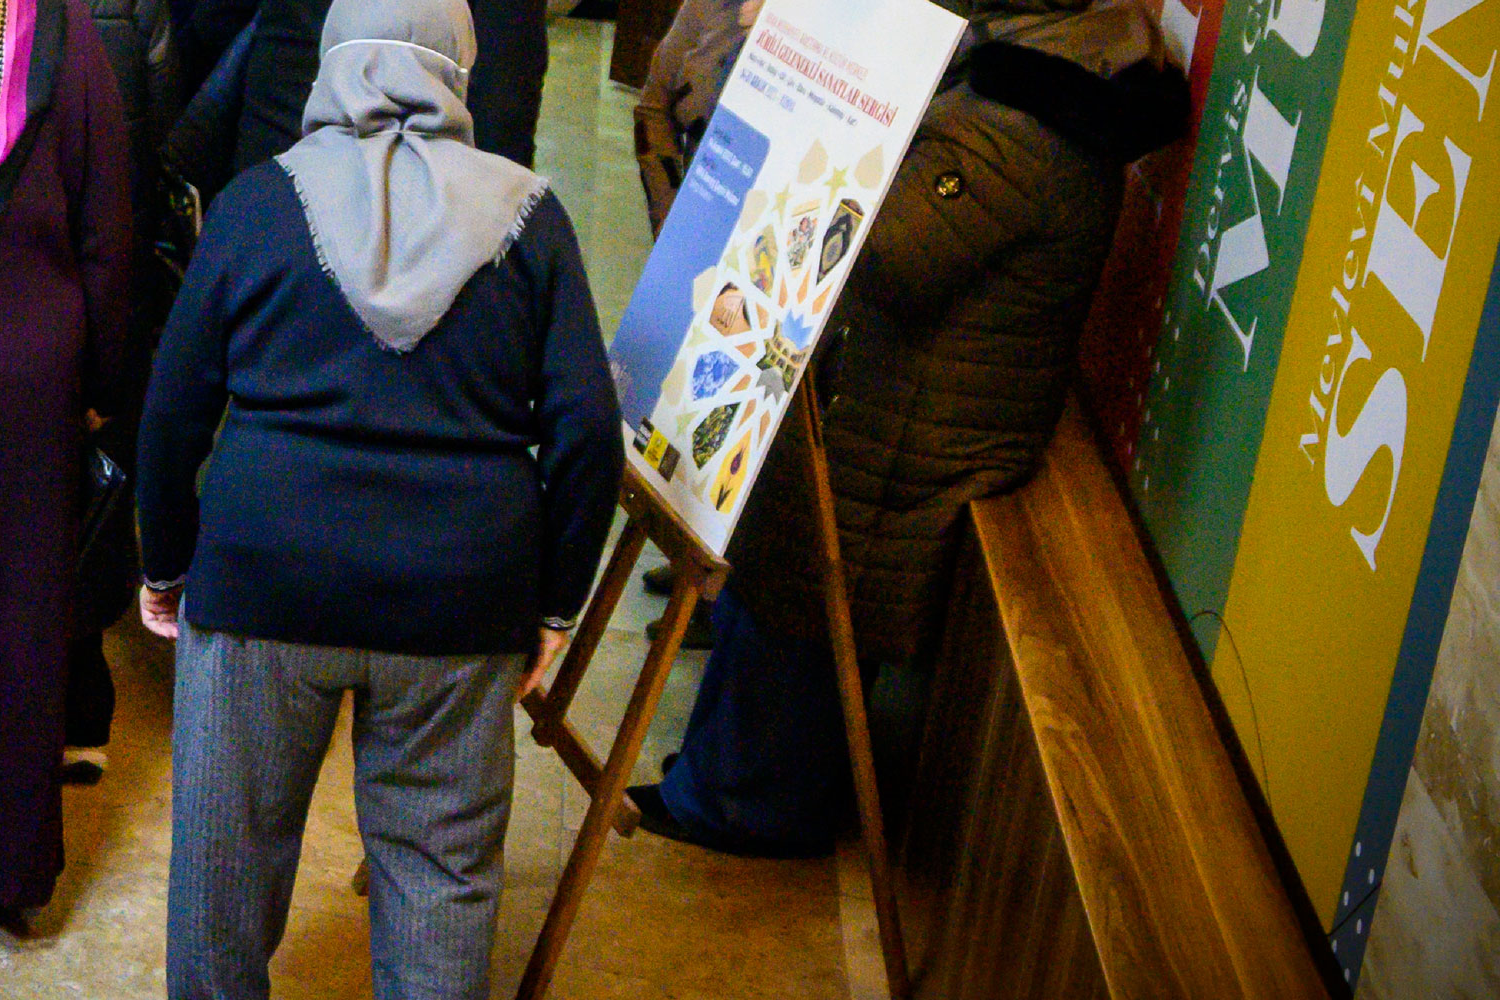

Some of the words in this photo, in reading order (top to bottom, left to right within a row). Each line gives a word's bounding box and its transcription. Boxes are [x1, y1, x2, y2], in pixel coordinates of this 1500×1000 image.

[815, 69, 862, 107] SANATLAR
[856, 96, 898, 127] SERGİSİ
[1194, 78, 1248, 299] Derviş
[1299, 176, 1375, 470] Mevlevî
